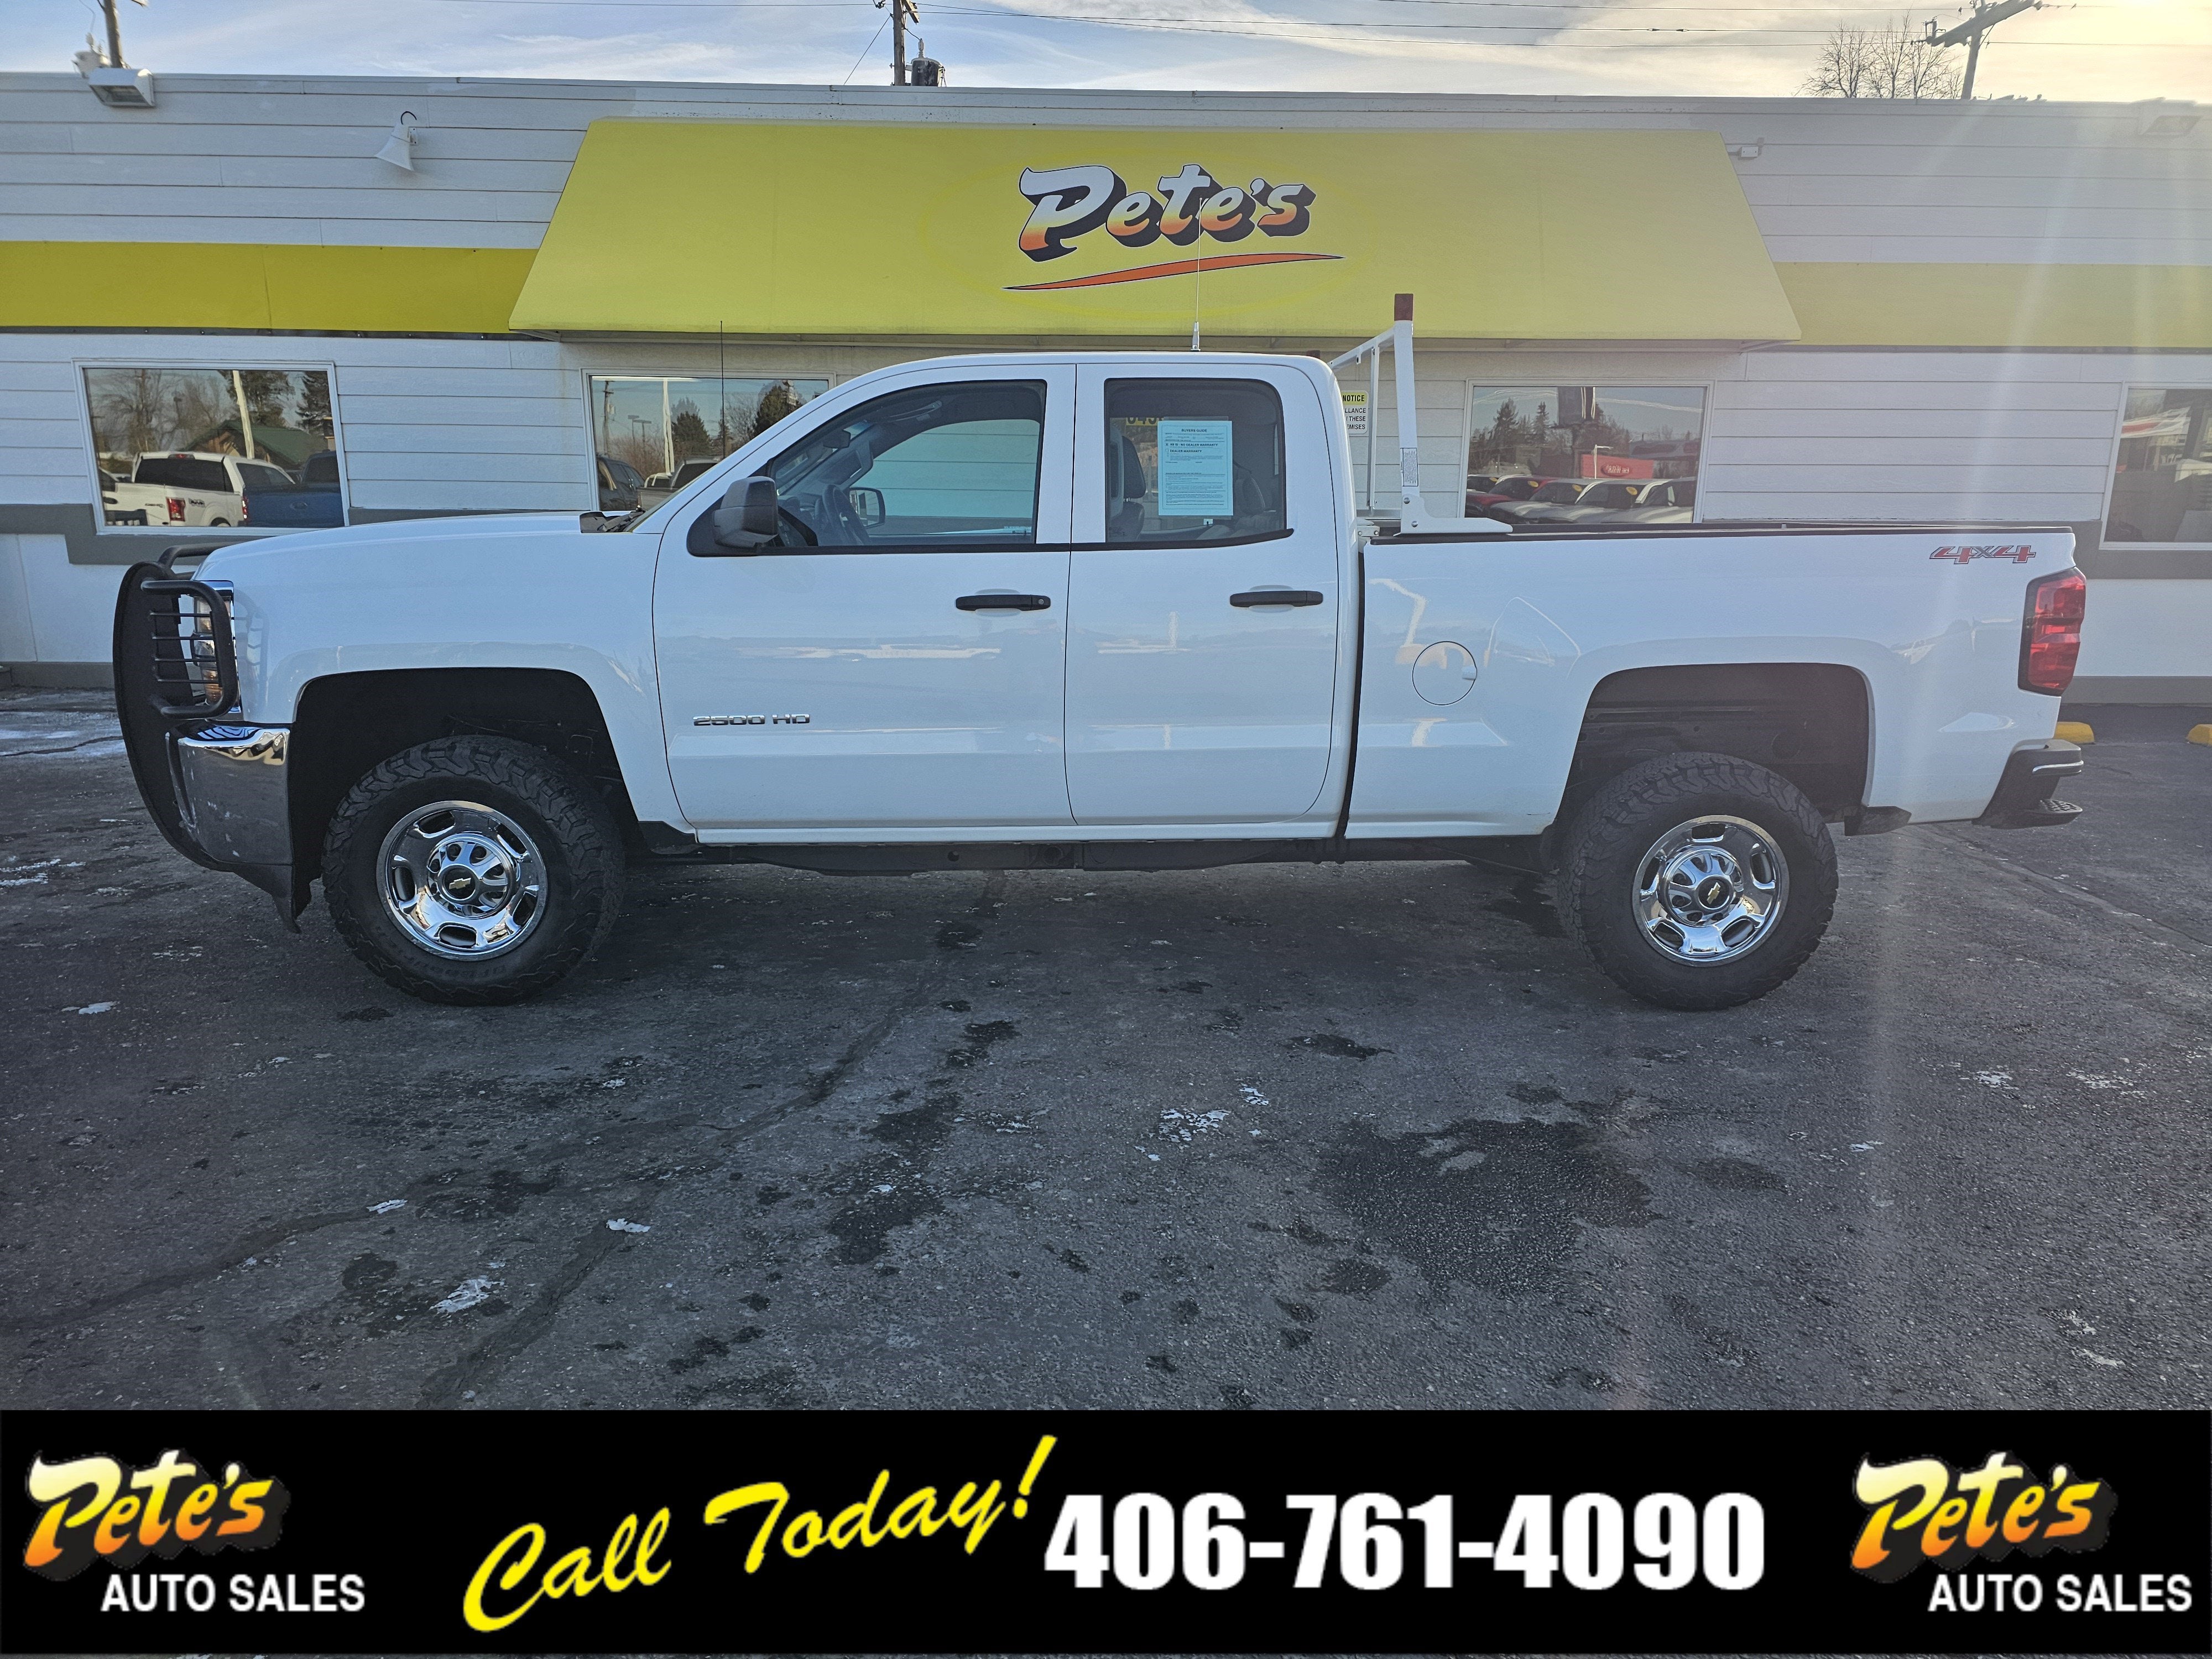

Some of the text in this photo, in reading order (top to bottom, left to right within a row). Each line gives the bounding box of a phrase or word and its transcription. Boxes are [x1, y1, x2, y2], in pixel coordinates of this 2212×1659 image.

[1018, 164, 1316, 262] Pete's
[693, 714, 810, 726] 2500 HD
